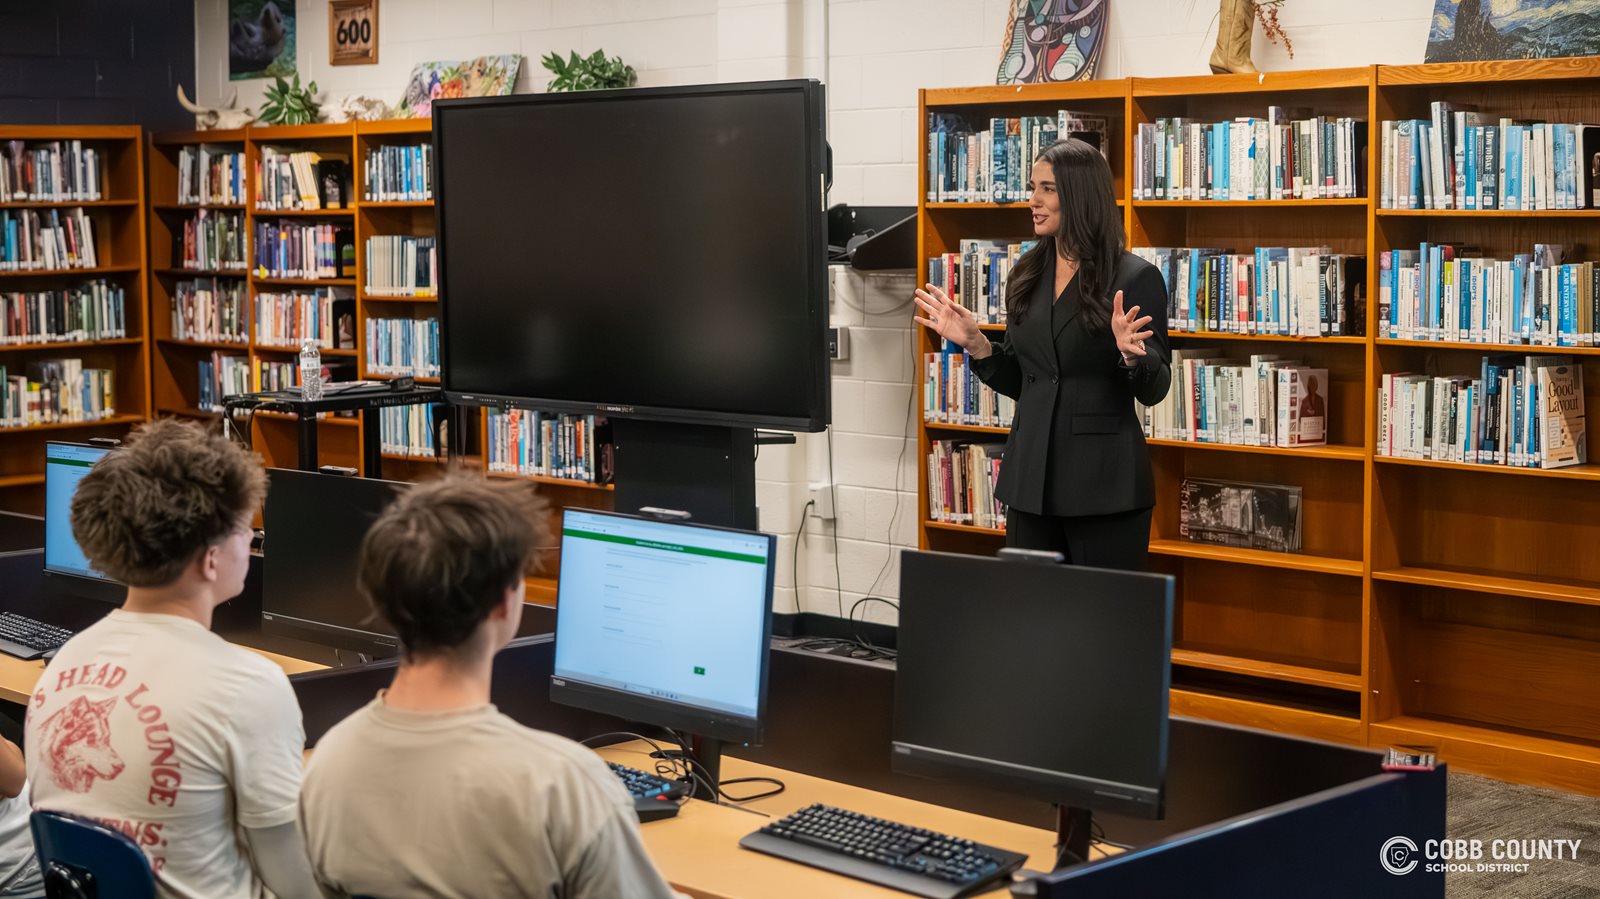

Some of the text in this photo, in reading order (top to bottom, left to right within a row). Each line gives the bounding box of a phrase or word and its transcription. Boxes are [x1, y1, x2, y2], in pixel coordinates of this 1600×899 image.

[336, 18, 371, 45] 600
[1485, 131, 1494, 171] HOW TO BAKE
[1319, 274, 1328, 319] mmmmiami
[1548, 379, 1574, 397] Good
[1382, 414, 1387, 423] TO
[1548, 397, 1579, 415] Layout
[55, 662, 128, 693] HEAD
[124, 682, 183, 808] LOUNGE
